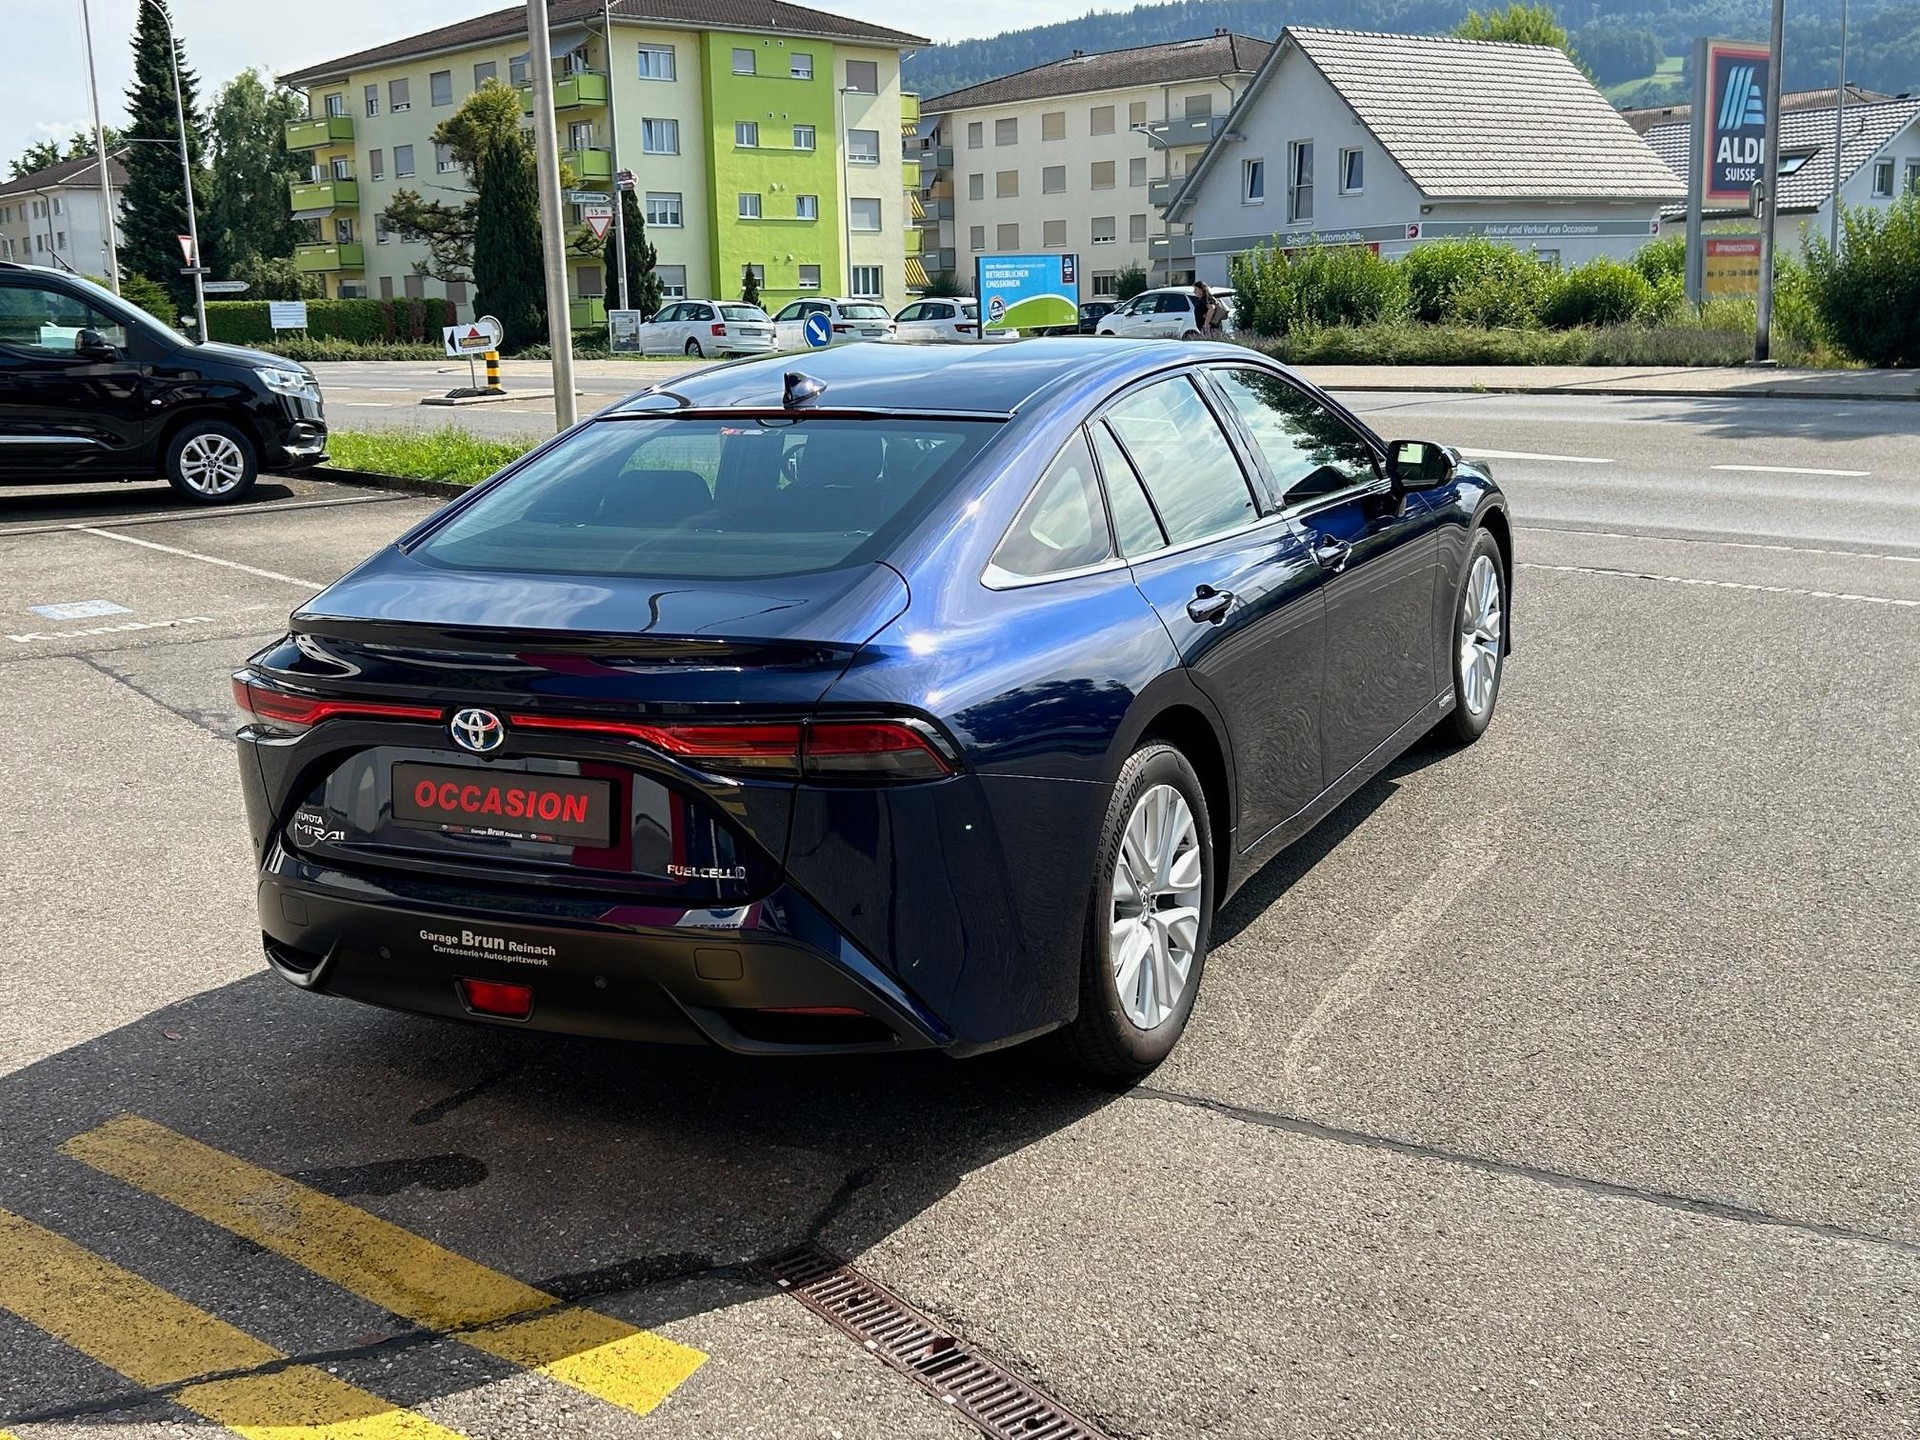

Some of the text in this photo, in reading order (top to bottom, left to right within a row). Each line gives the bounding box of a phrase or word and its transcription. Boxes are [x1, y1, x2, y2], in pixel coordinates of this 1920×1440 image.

[1716, 136, 1765, 164] ALDI
[1725, 168, 1756, 181] SUISSE
[1484, 224, 1598, 235] Ankauf und Verkauf von Occasionen
[414, 779, 589, 824] OCCASION
[298, 811, 324, 825] TOYOTA
[1104, 768, 1146, 884] BRIDGESTONE
[295, 821, 346, 841] MIRAI
[487, 827, 505, 836] Brun
[419, 929, 556, 956] Garage Brun Reinach
